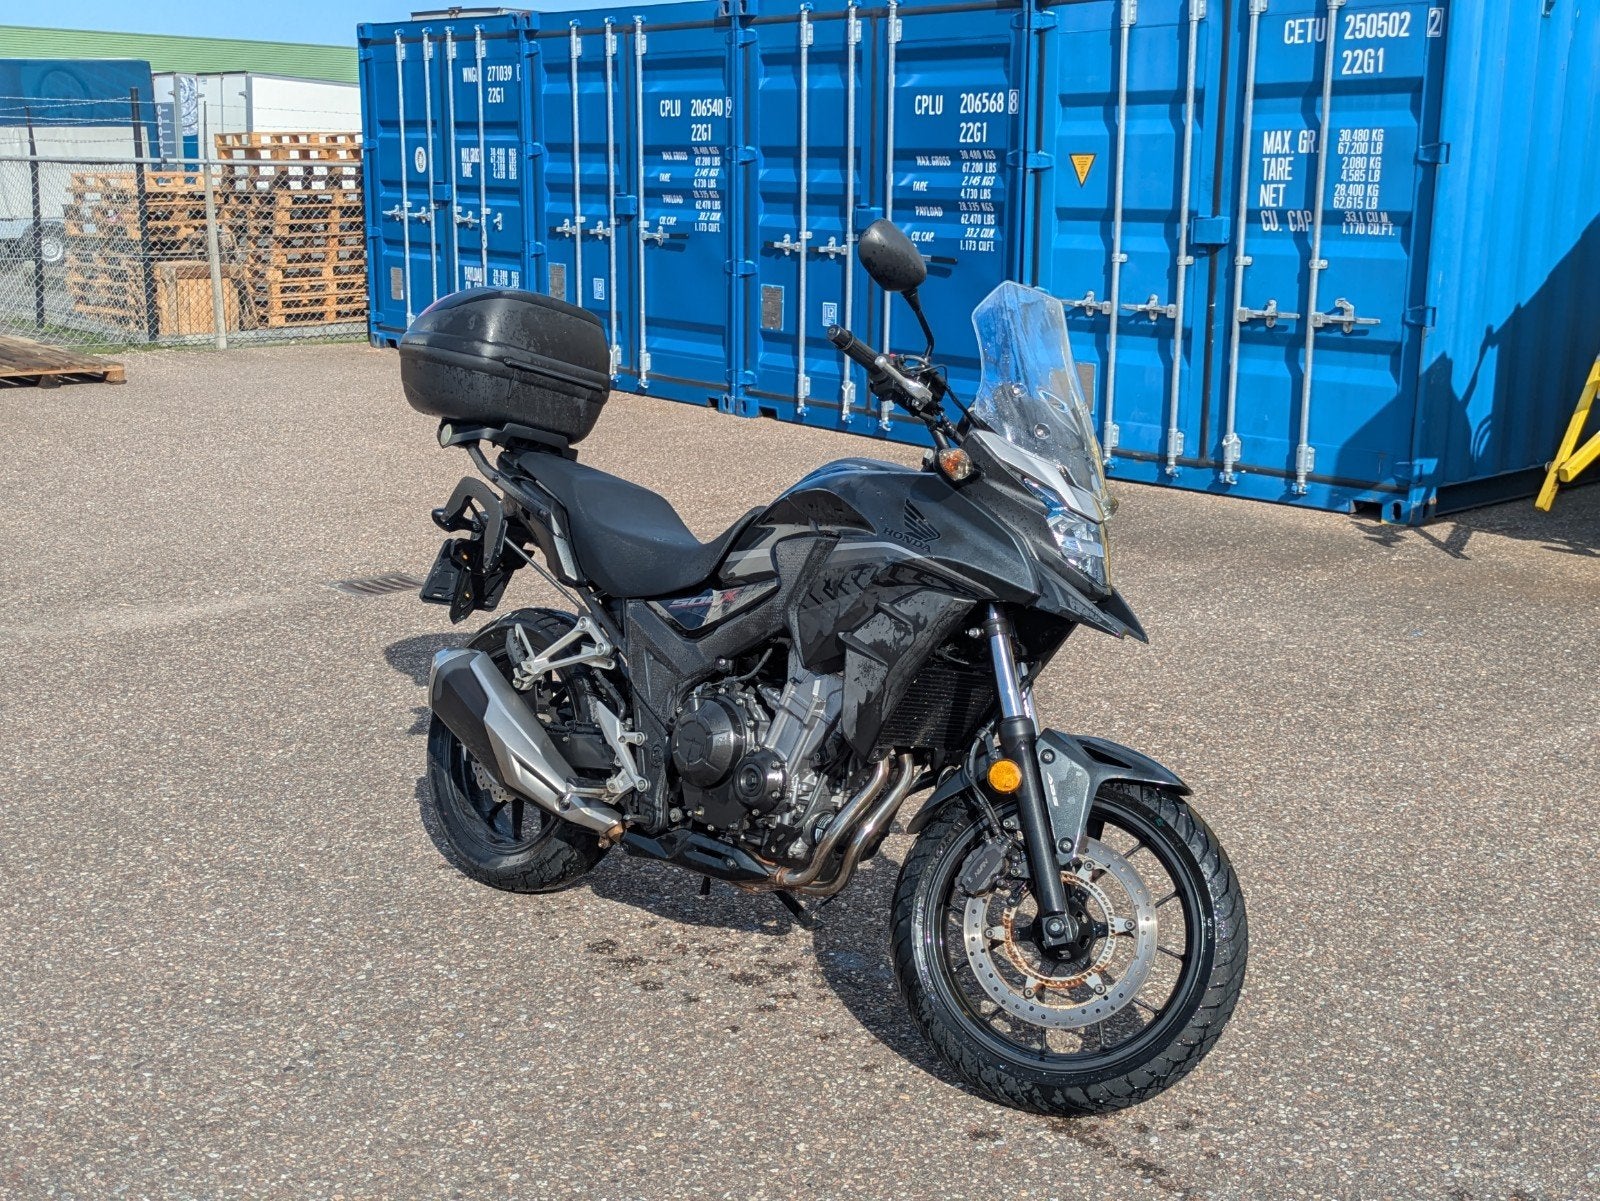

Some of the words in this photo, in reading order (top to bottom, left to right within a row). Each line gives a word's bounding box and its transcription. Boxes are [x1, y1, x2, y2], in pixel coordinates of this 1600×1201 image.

[1284, 18, 1326, 44] CETU
[1344, 11, 1411, 40] 250502
[1428, 9, 1442, 37] 2
[1341, 47, 1384, 75] 22G1
[487, 65, 513, 82] 271039
[487, 87, 504, 103] 22G1
[660, 99, 681, 117] CPLU
[690, 98, 723, 117] 206540
[915, 94, 944, 115] CPLU
[960, 91, 1004, 114] 206568
[1008, 90, 1018, 114] 8
[691, 123, 712, 141] 22G1
[959, 122, 987, 143] 22G1
[1371, 128, 1384, 142] KG
[1263, 130, 1295, 155] MAX.
[1371, 142, 1383, 155] LB
[712, 156, 721, 166] LBS
[916, 156, 951, 166] MAX.GROSS
[983, 149, 996, 160] KGS
[985, 162, 997, 173] LBS
[1262, 157, 1294, 181] TARE
[1369, 157, 1382, 170] KG
[981, 175, 996, 186] KGS
[1368, 170, 1381, 182] LB
[708, 179, 717, 188] LBS
[912, 181, 928, 192] TARE
[980, 188, 992, 200] LBS
[1260, 184, 1286, 208] NET
[1367, 184, 1380, 197] KG
[712, 200, 721, 210] LBS
[981, 202, 995, 212] KGS
[1365, 197, 1378, 210] LB
[915, 206, 943, 217] PAYLOAD
[1344, 211, 1364, 223] 33.1
[983, 214, 995, 225] LBS
[1261, 210, 1283, 232] CU.
[883, 527, 931, 553] HONDA
